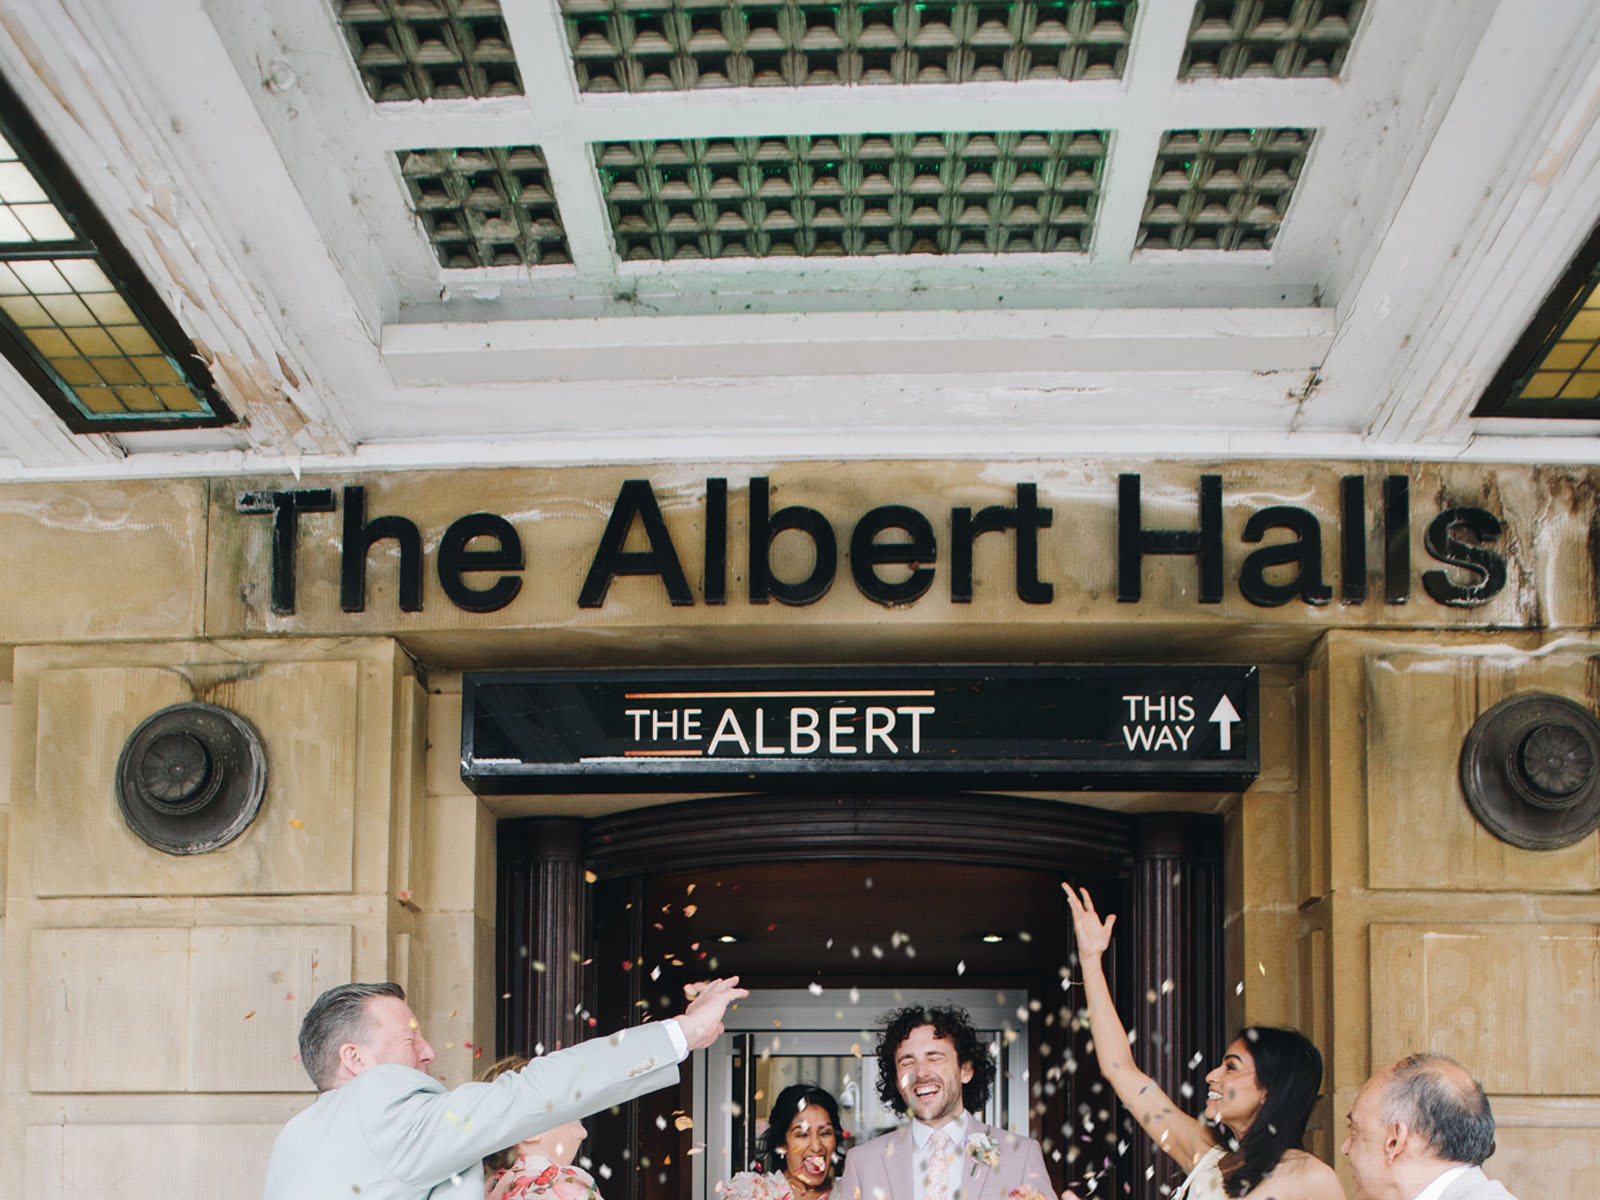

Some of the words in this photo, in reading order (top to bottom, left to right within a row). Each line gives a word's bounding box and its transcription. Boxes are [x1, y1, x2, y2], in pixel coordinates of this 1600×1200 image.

[236, 484, 526, 616] The
[577, 475, 1054, 609] Albert
[1117, 473, 1508, 609] Halls
[1122, 695, 1196, 722] THIS
[624, 708, 702, 741] THE
[707, 706, 936, 755] ALBERT
[1122, 725, 1196, 752] WAY
